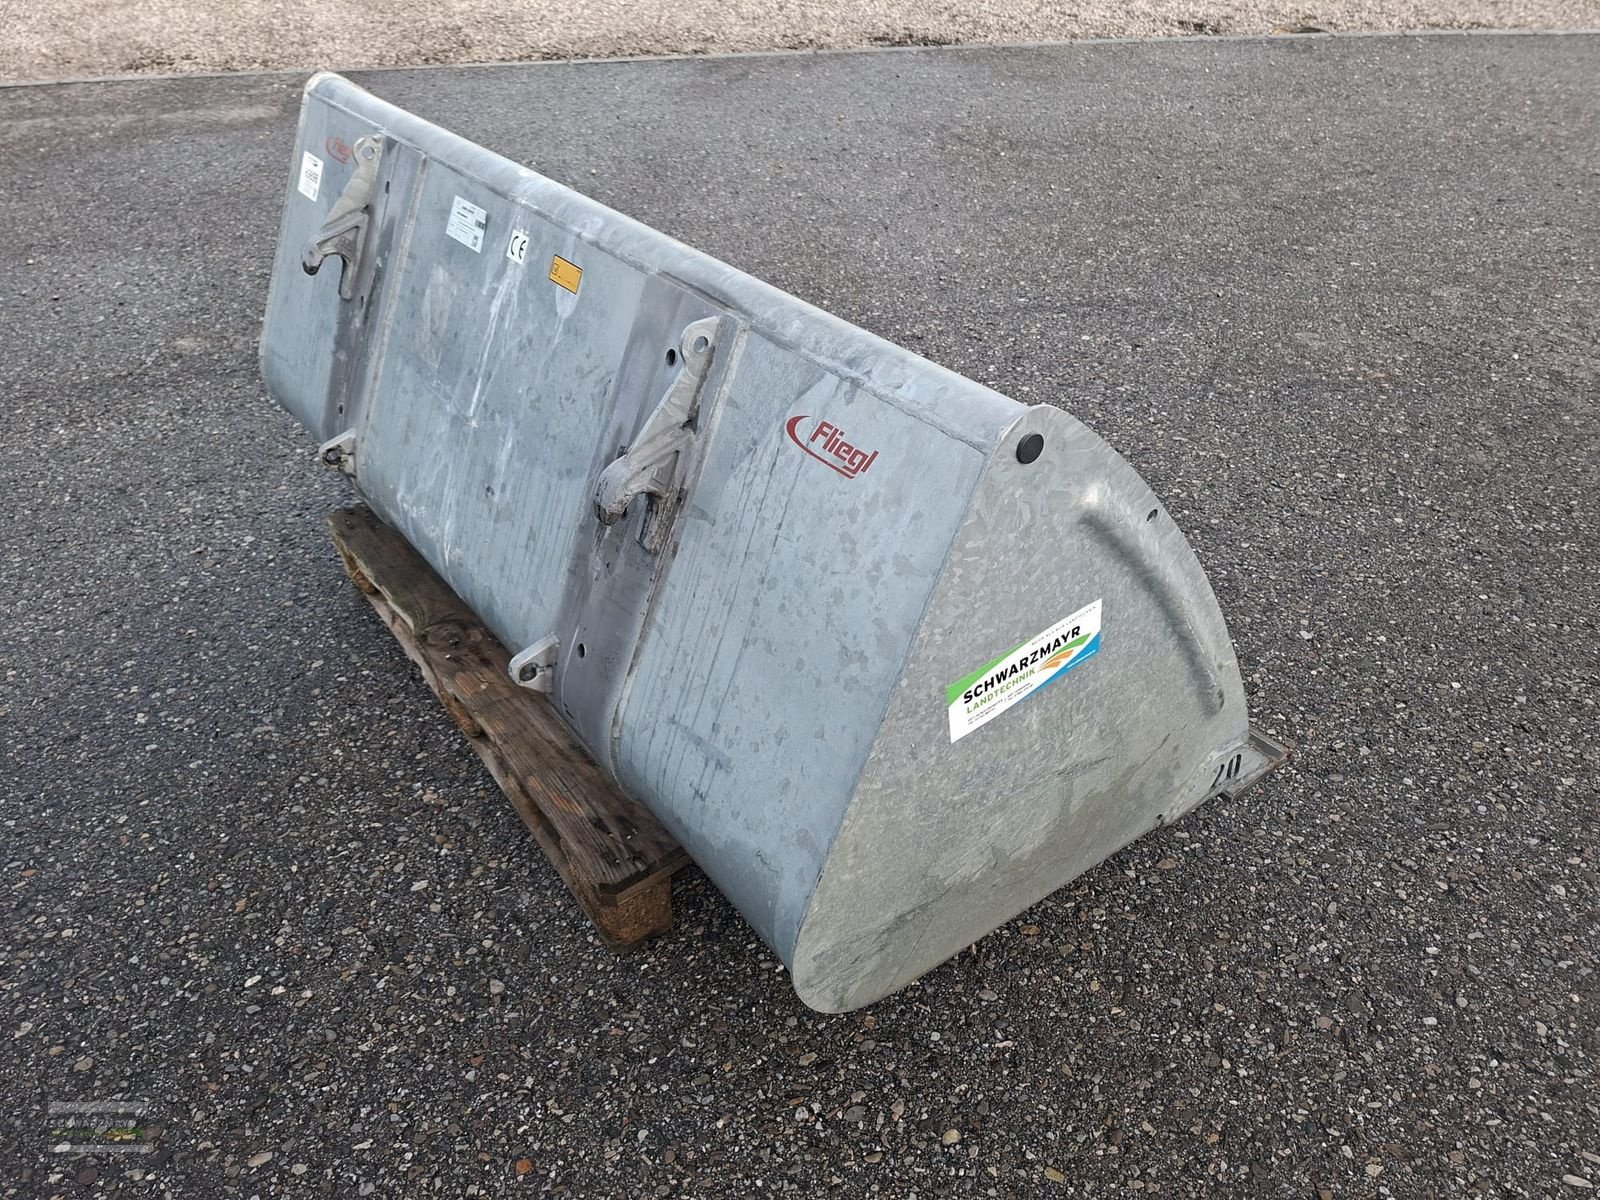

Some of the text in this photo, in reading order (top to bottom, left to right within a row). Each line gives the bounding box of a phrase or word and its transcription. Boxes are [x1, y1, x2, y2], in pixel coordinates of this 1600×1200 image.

[511, 235, 527, 260] CE
[809, 420, 879, 475] Fliegl
[963, 625, 1081, 704] SCHWARZMAYR
[966, 668, 1036, 714] LANDTECHNIK
